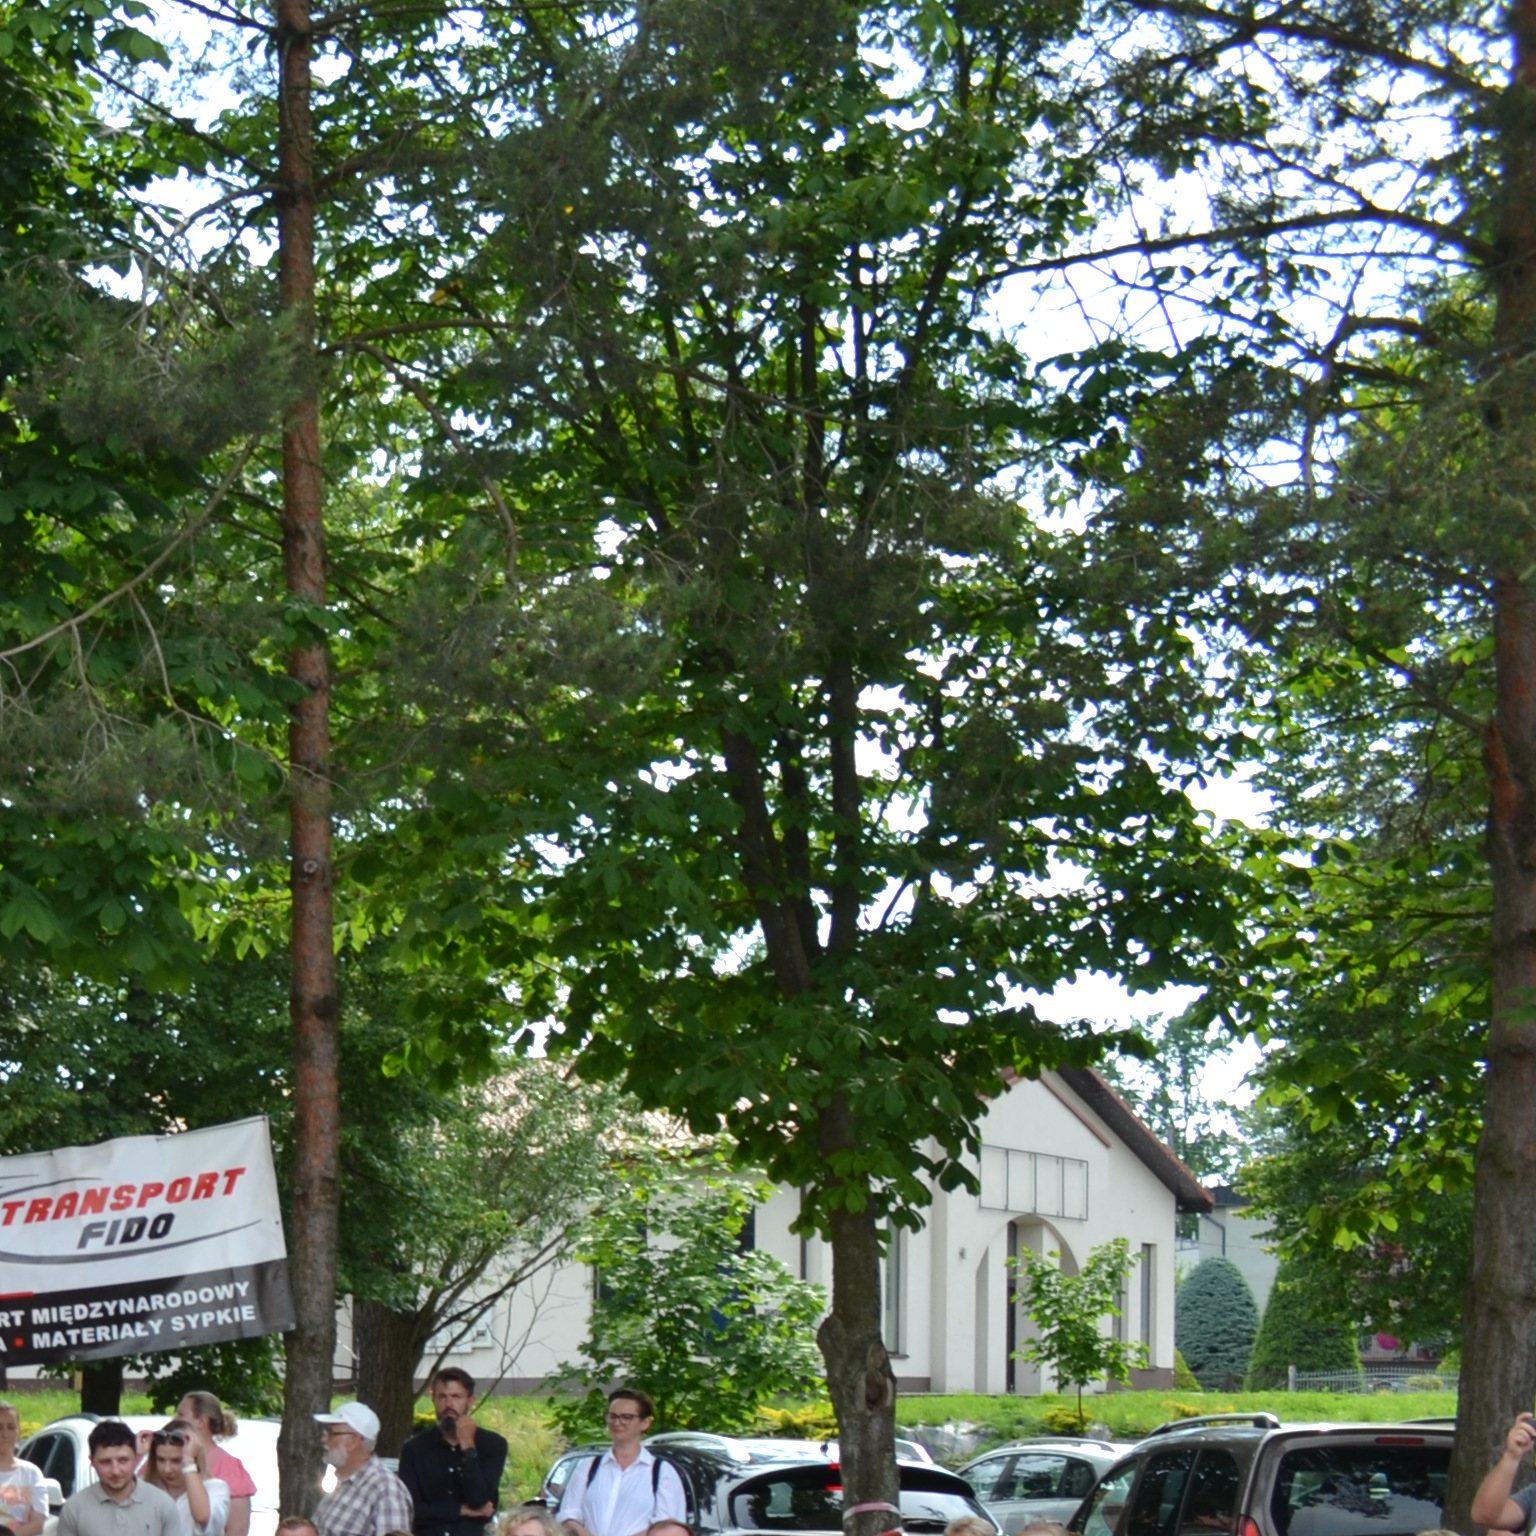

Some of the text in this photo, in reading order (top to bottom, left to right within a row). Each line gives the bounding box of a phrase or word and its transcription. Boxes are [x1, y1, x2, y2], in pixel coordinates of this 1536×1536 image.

[1, 1167, 247, 1226] TRANSPORT
[77, 1212, 176, 1249] FIDO
[31, 1281, 250, 1325] MIĘDZYNARODOWY
[32, 1318, 164, 1350] MATERIAŁY
[171, 1304, 257, 1333] SYPKIE
